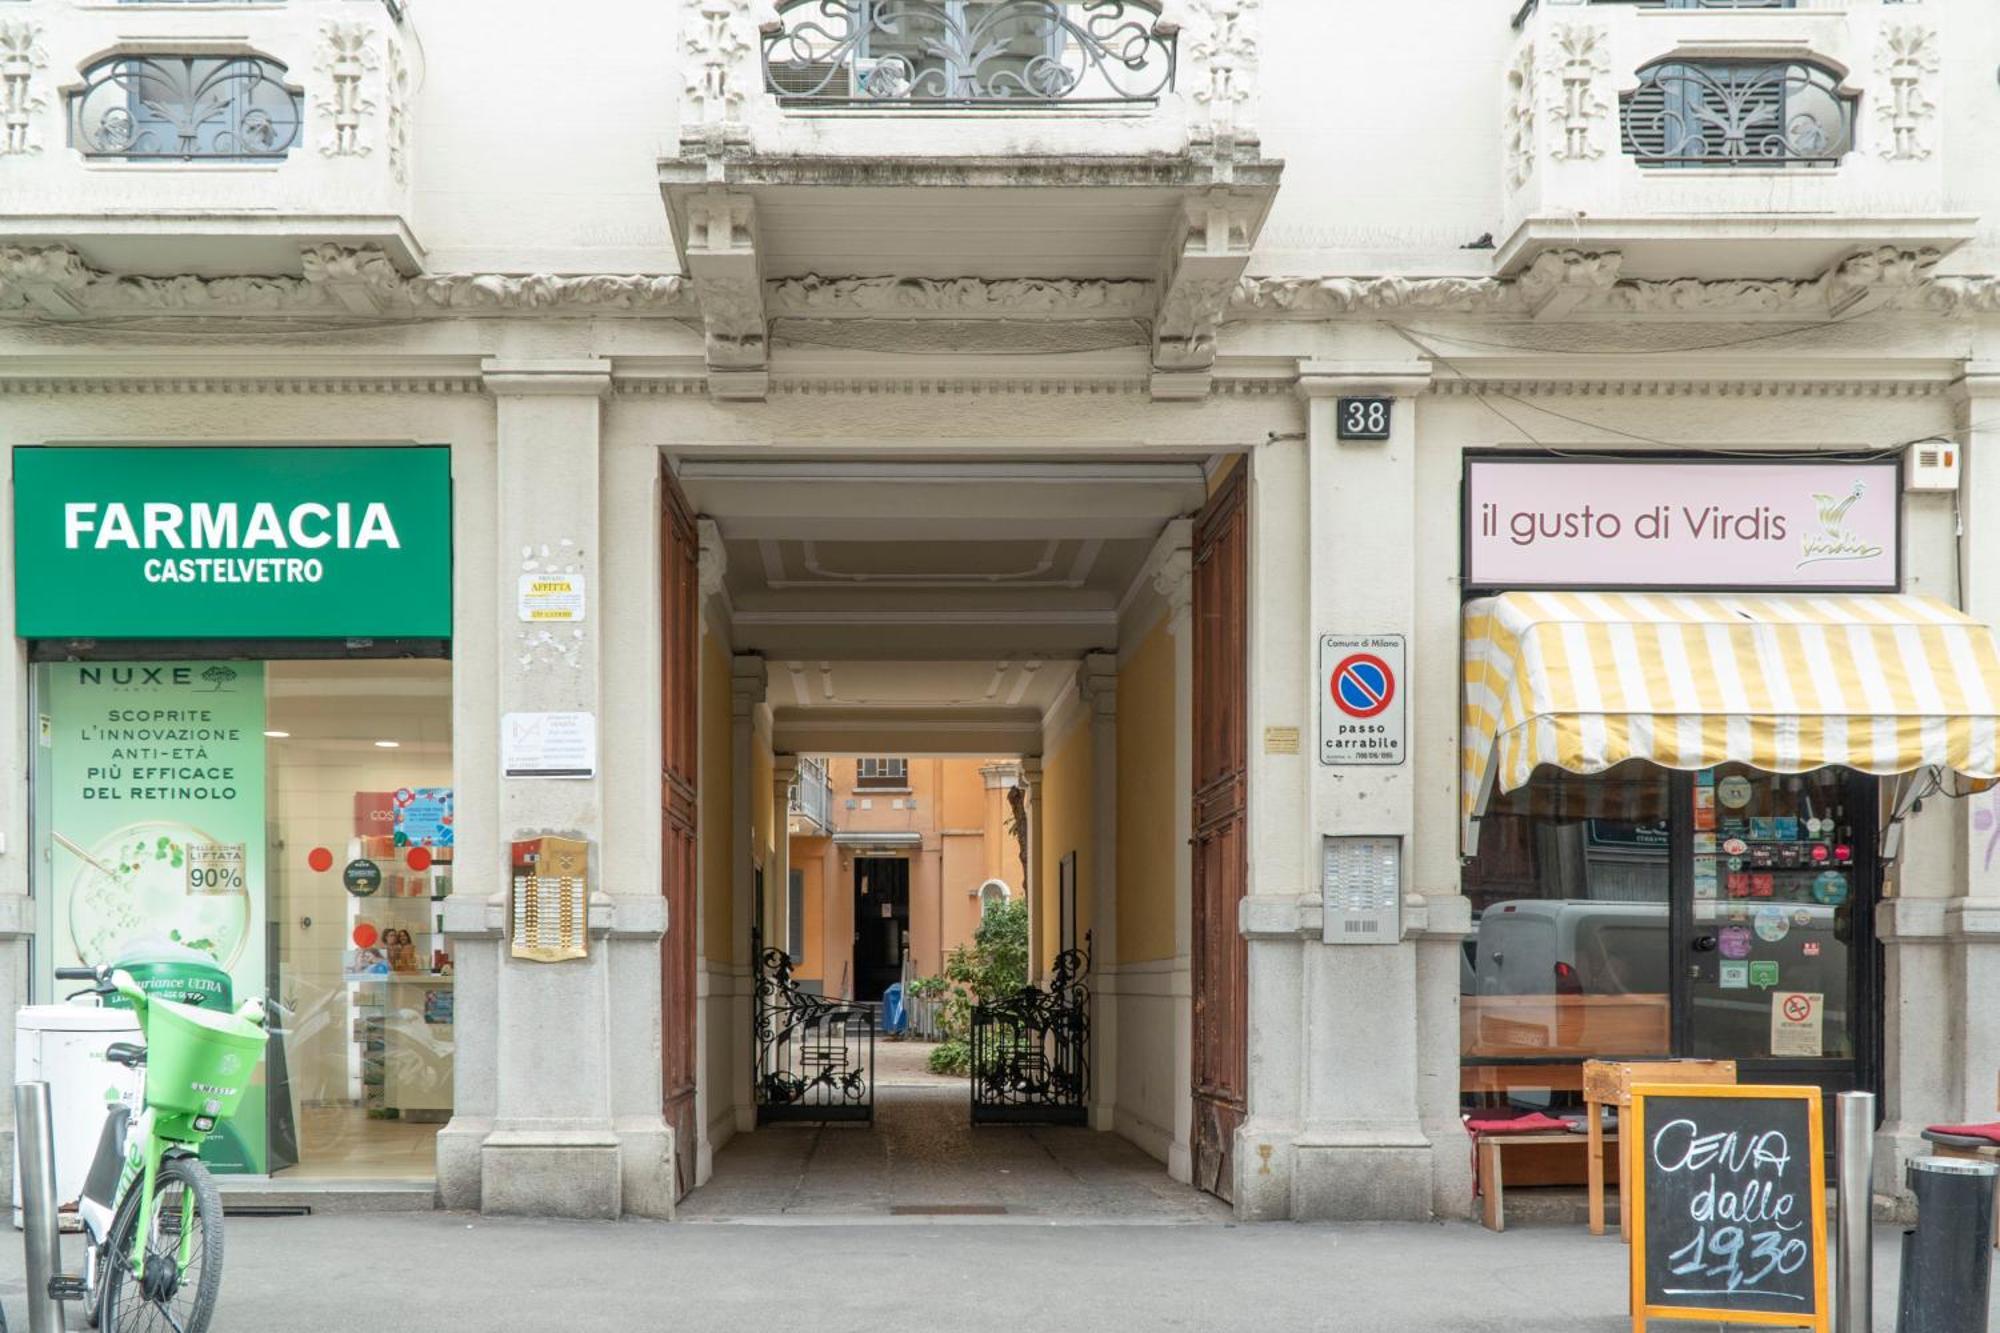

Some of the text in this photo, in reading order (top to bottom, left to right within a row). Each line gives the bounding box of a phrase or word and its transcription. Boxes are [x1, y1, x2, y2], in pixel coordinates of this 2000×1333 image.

[1346, 402, 1385, 433] 38
[64, 501, 401, 549] FARMACIA
[1481, 503, 1787, 546] il gusto di Virdis
[143, 558, 323, 584] CASTELVETRO
[1327, 639, 1399, 648] Comune di Milano
[79, 667, 193, 685] NUXE
[108, 710, 212, 722] SCOPRITE
[81, 725, 241, 741] L'INNOVAZIONE
[1339, 724, 1385, 736] passo
[111, 743, 209, 760] ANTI-ETÀ
[1326, 737, 1398, 749] carrabile
[87, 764, 235, 780] PIÙ EFFICACE
[83, 787, 237, 800] DEL RETINOLO
[191, 868, 242, 888] 90%
[1653, 1119, 1791, 1178] CENA
[1690, 1172, 1803, 1231] dalle
